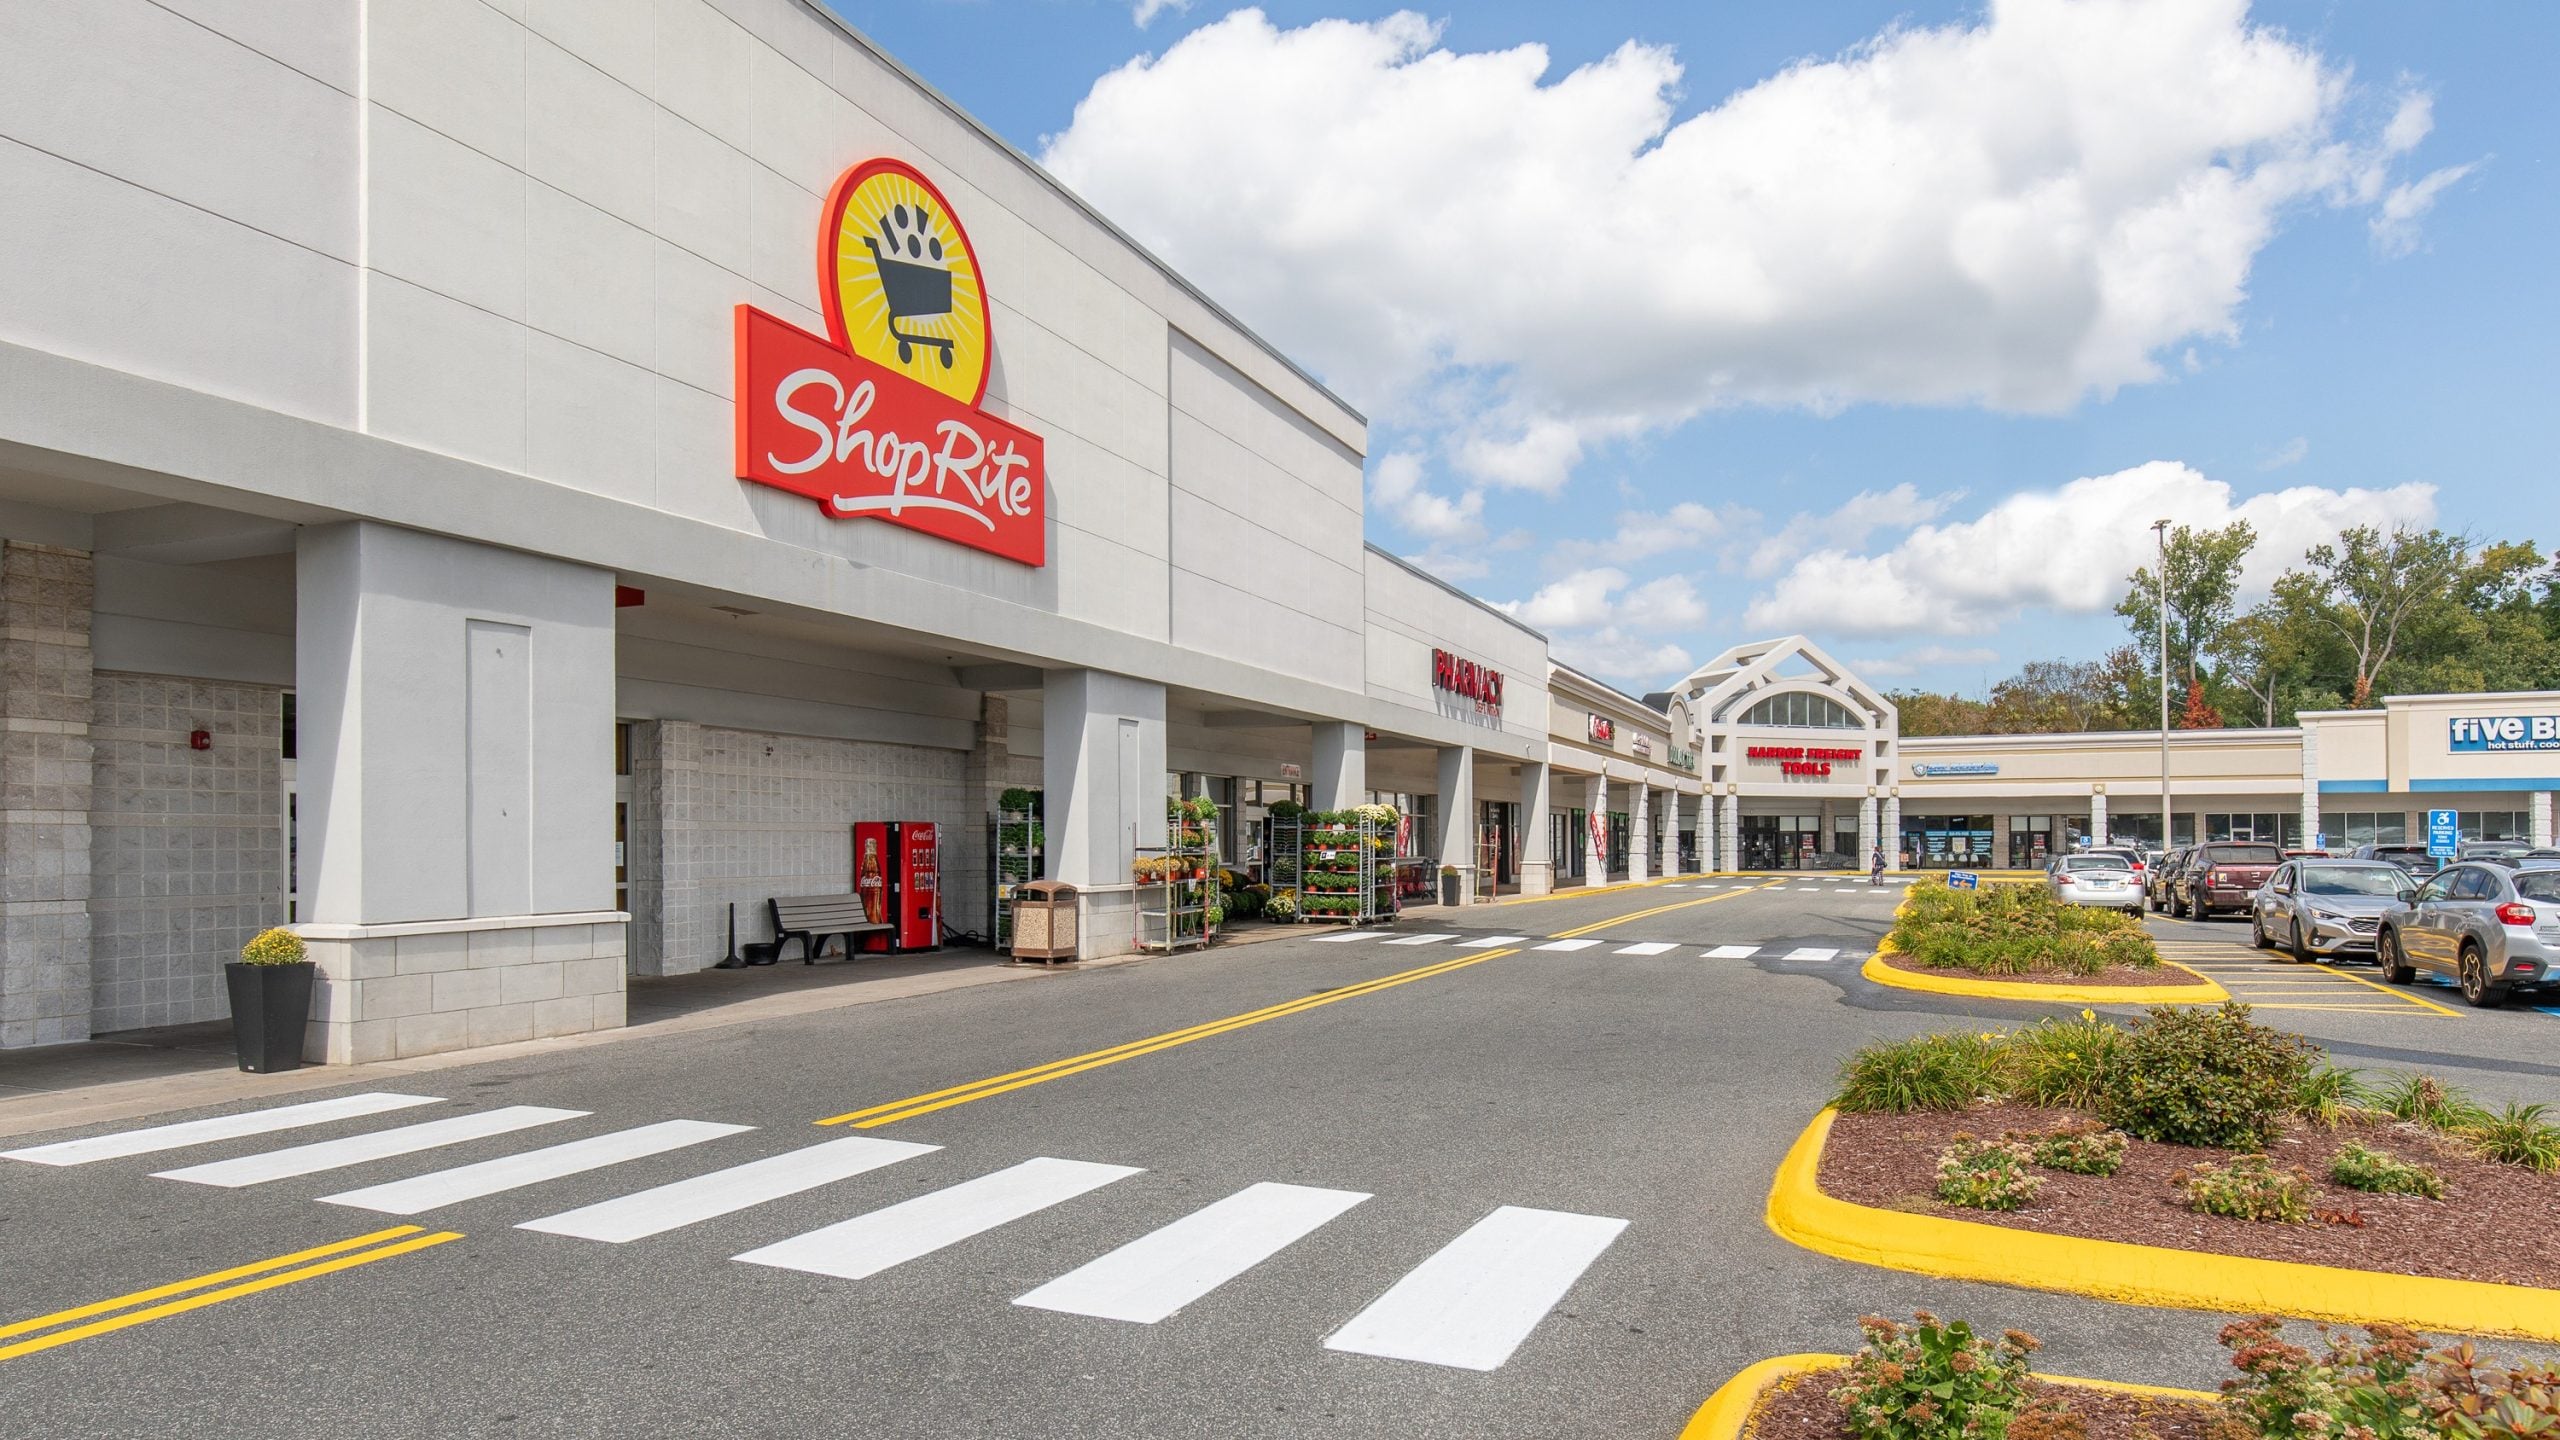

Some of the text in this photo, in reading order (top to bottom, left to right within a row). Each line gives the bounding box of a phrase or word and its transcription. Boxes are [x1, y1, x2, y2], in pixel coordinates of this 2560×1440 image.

[768, 368, 1032, 524] ShopRite
[1432, 648, 1504, 706] PHARMACY
[2452, 717, 2525, 742] five
[2487, 741, 2507, 749] hot
[2508, 739, 2537, 749] stuff.
[1747, 747, 1862, 759] HARBOR FREIGHT
[1782, 762, 1831, 775] TOOLS
[860, 875, 883, 888] Coca-Cola
